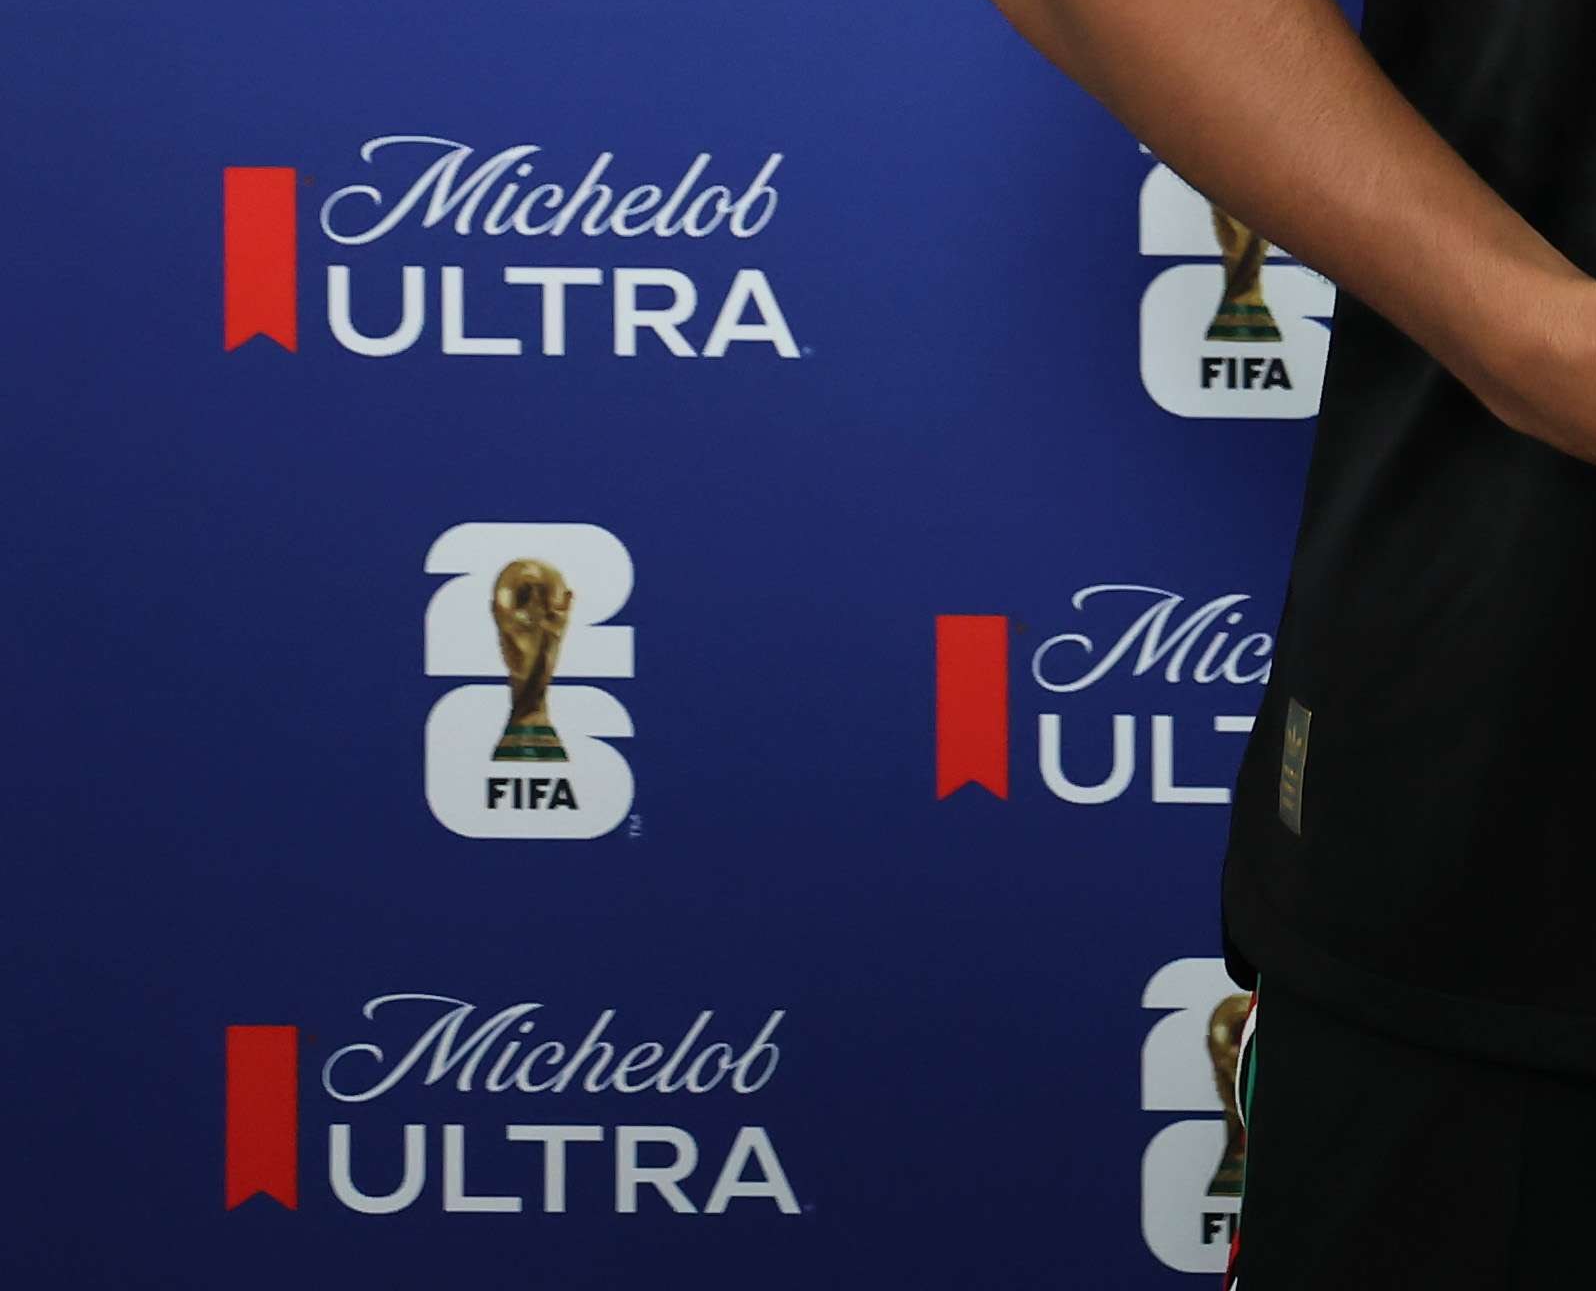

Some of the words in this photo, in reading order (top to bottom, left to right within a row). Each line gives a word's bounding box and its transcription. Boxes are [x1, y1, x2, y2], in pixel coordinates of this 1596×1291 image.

[321, 136, 782, 245] Michelob
[327, 265, 800, 358] ULTRA
[1200, 356, 1292, 390] FIFA
[486, 776, 579, 811] FIFA
[323, 994, 785, 1102] Michelob
[329, 1124, 801, 1214] ULTRA
